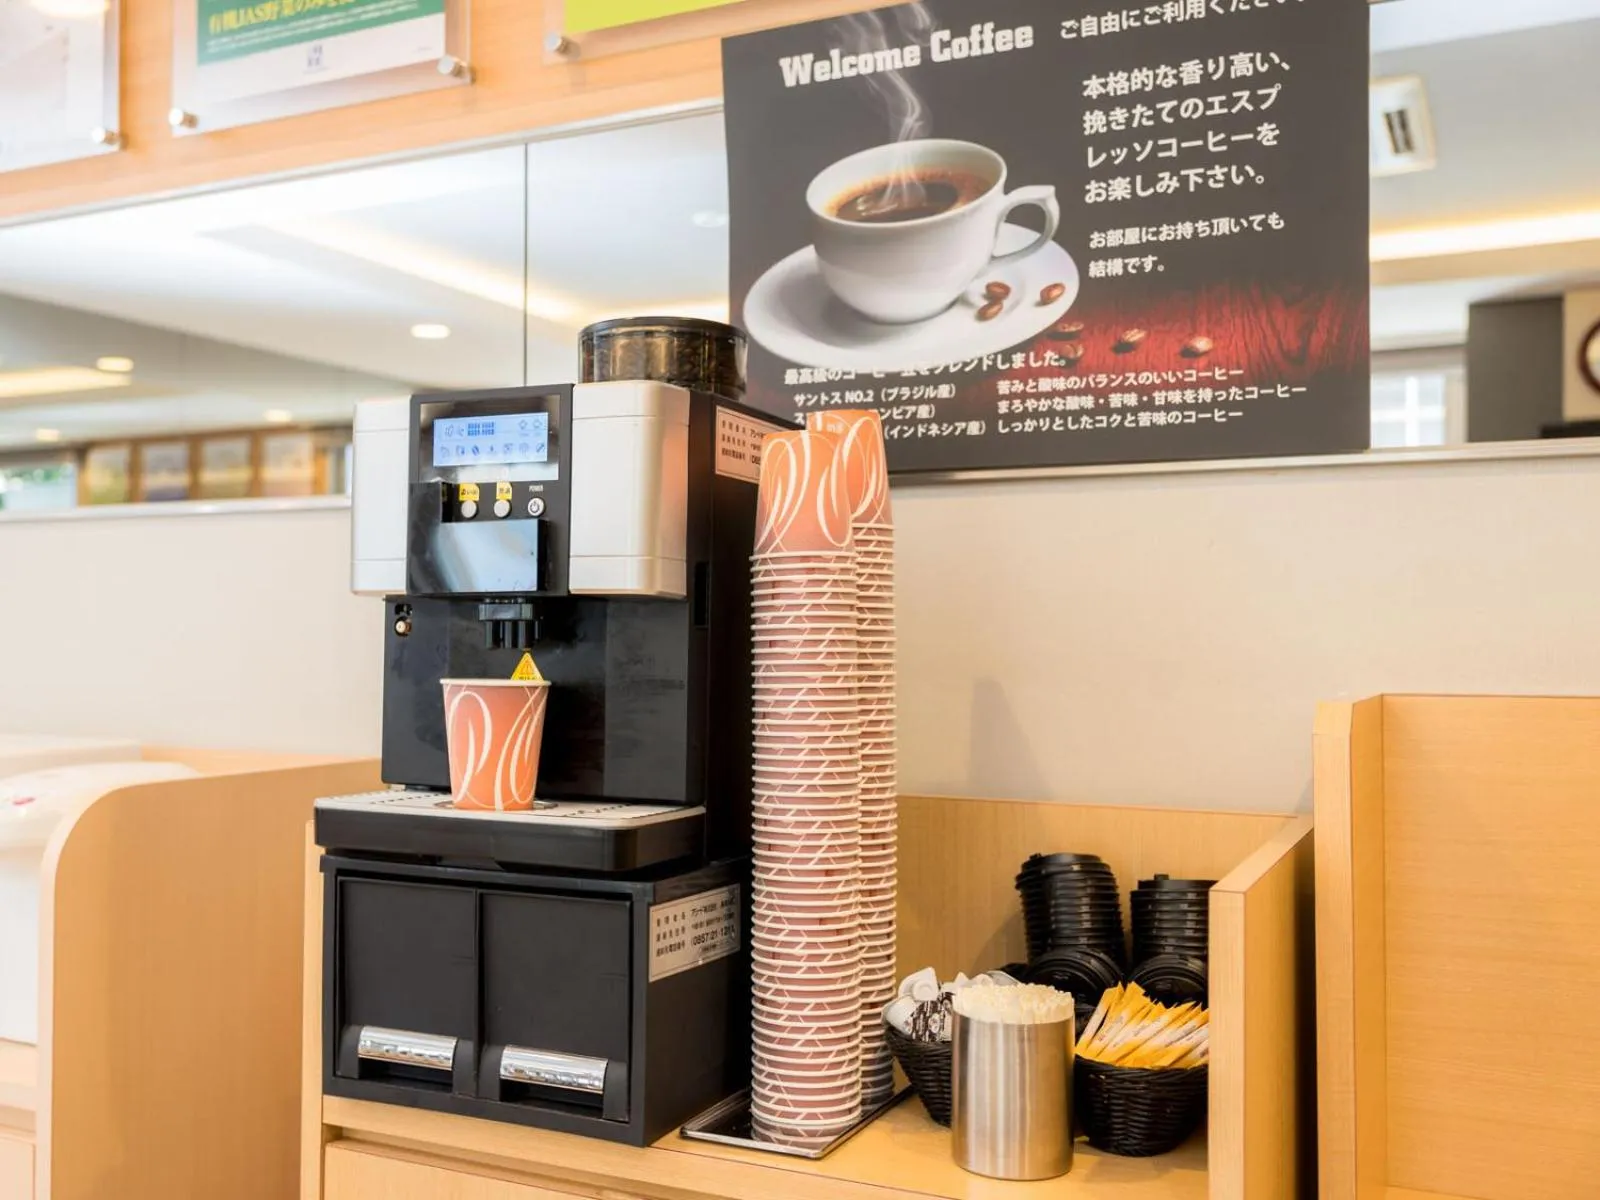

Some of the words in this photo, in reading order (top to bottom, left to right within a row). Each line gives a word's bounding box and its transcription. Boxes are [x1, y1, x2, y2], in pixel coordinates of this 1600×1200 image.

[778, 44, 921, 88] Welcome
[930, 21, 1034, 63] Coffee
[1082, 51, 1290, 99] 本格的な香り高い、
[1082, 83, 1282, 135] 挽きたてのエスプ
[1086, 122, 1280, 169] レッソコーヒーを
[1084, 164, 1265, 204] お楽しみ下さい。
[1089, 212, 1285, 249] お部屋にお持ち頂いても
[1088, 254, 1165, 278] 結構です。
[996, 366, 1244, 395] 苦みと酸味のバランスのいいコーヒー
[998, 408, 1244, 433] しっかりとしたコクと苦味のコーヒー
